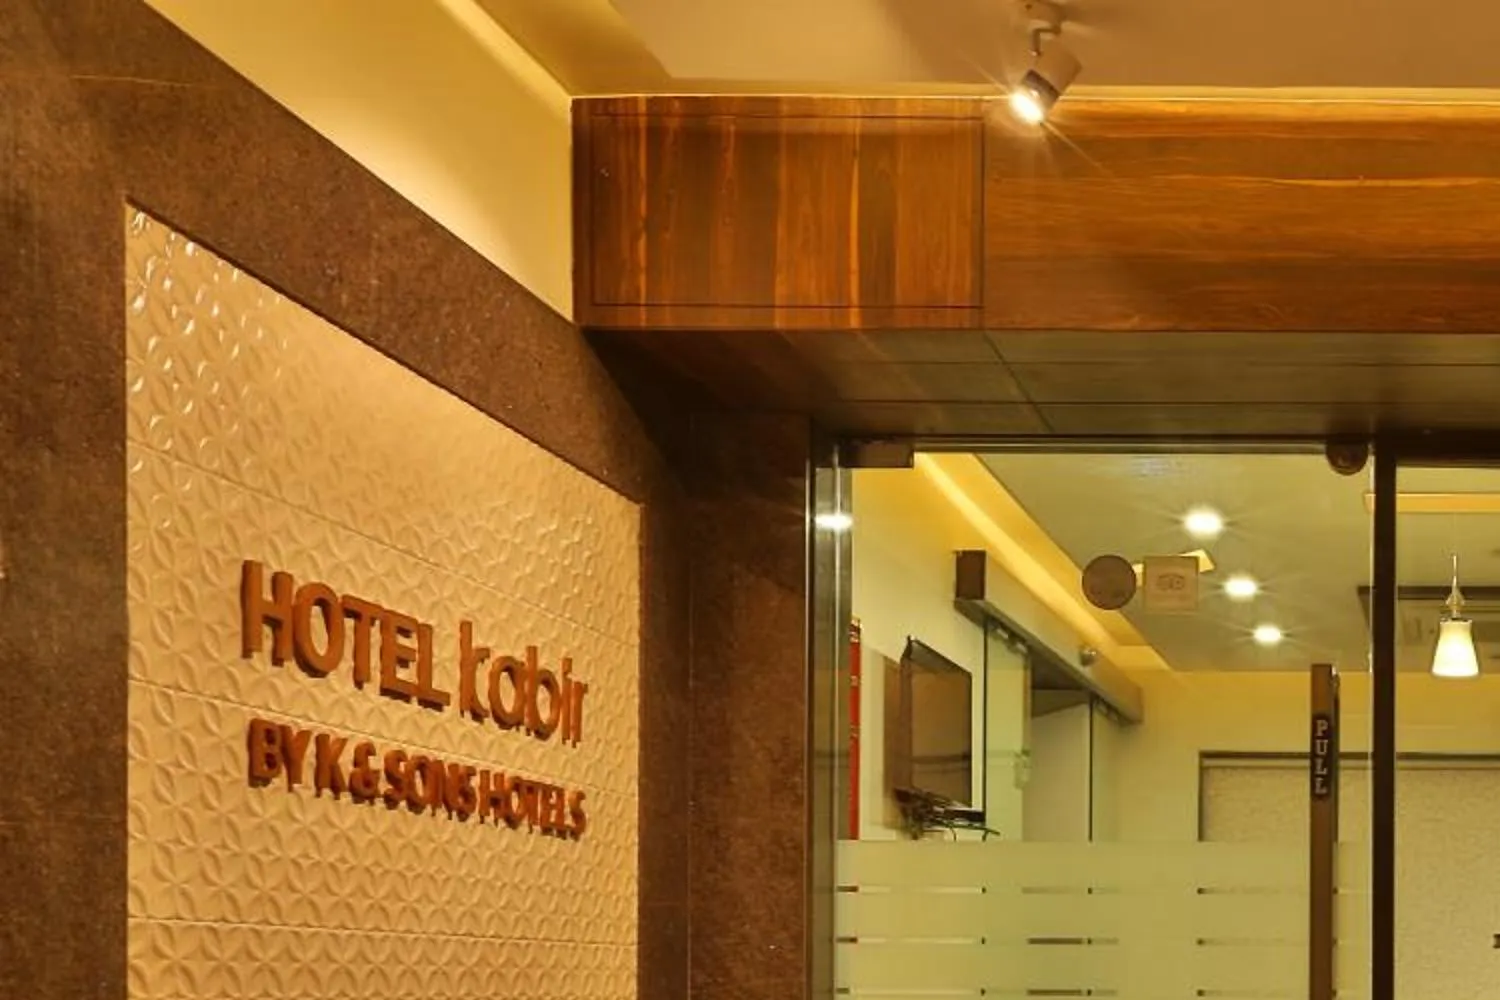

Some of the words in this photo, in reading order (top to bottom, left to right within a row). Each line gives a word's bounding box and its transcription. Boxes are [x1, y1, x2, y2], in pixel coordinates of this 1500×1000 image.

[241, 559, 450, 711] HOTEL
[247, 718, 312, 792] BY
[314, 733, 349, 800] K
[349, 740, 380, 806] &
[383, 750, 476, 822] SONS
[479, 769, 586, 842] HOTELS
[1314, 719, 1329, 795] PULL
